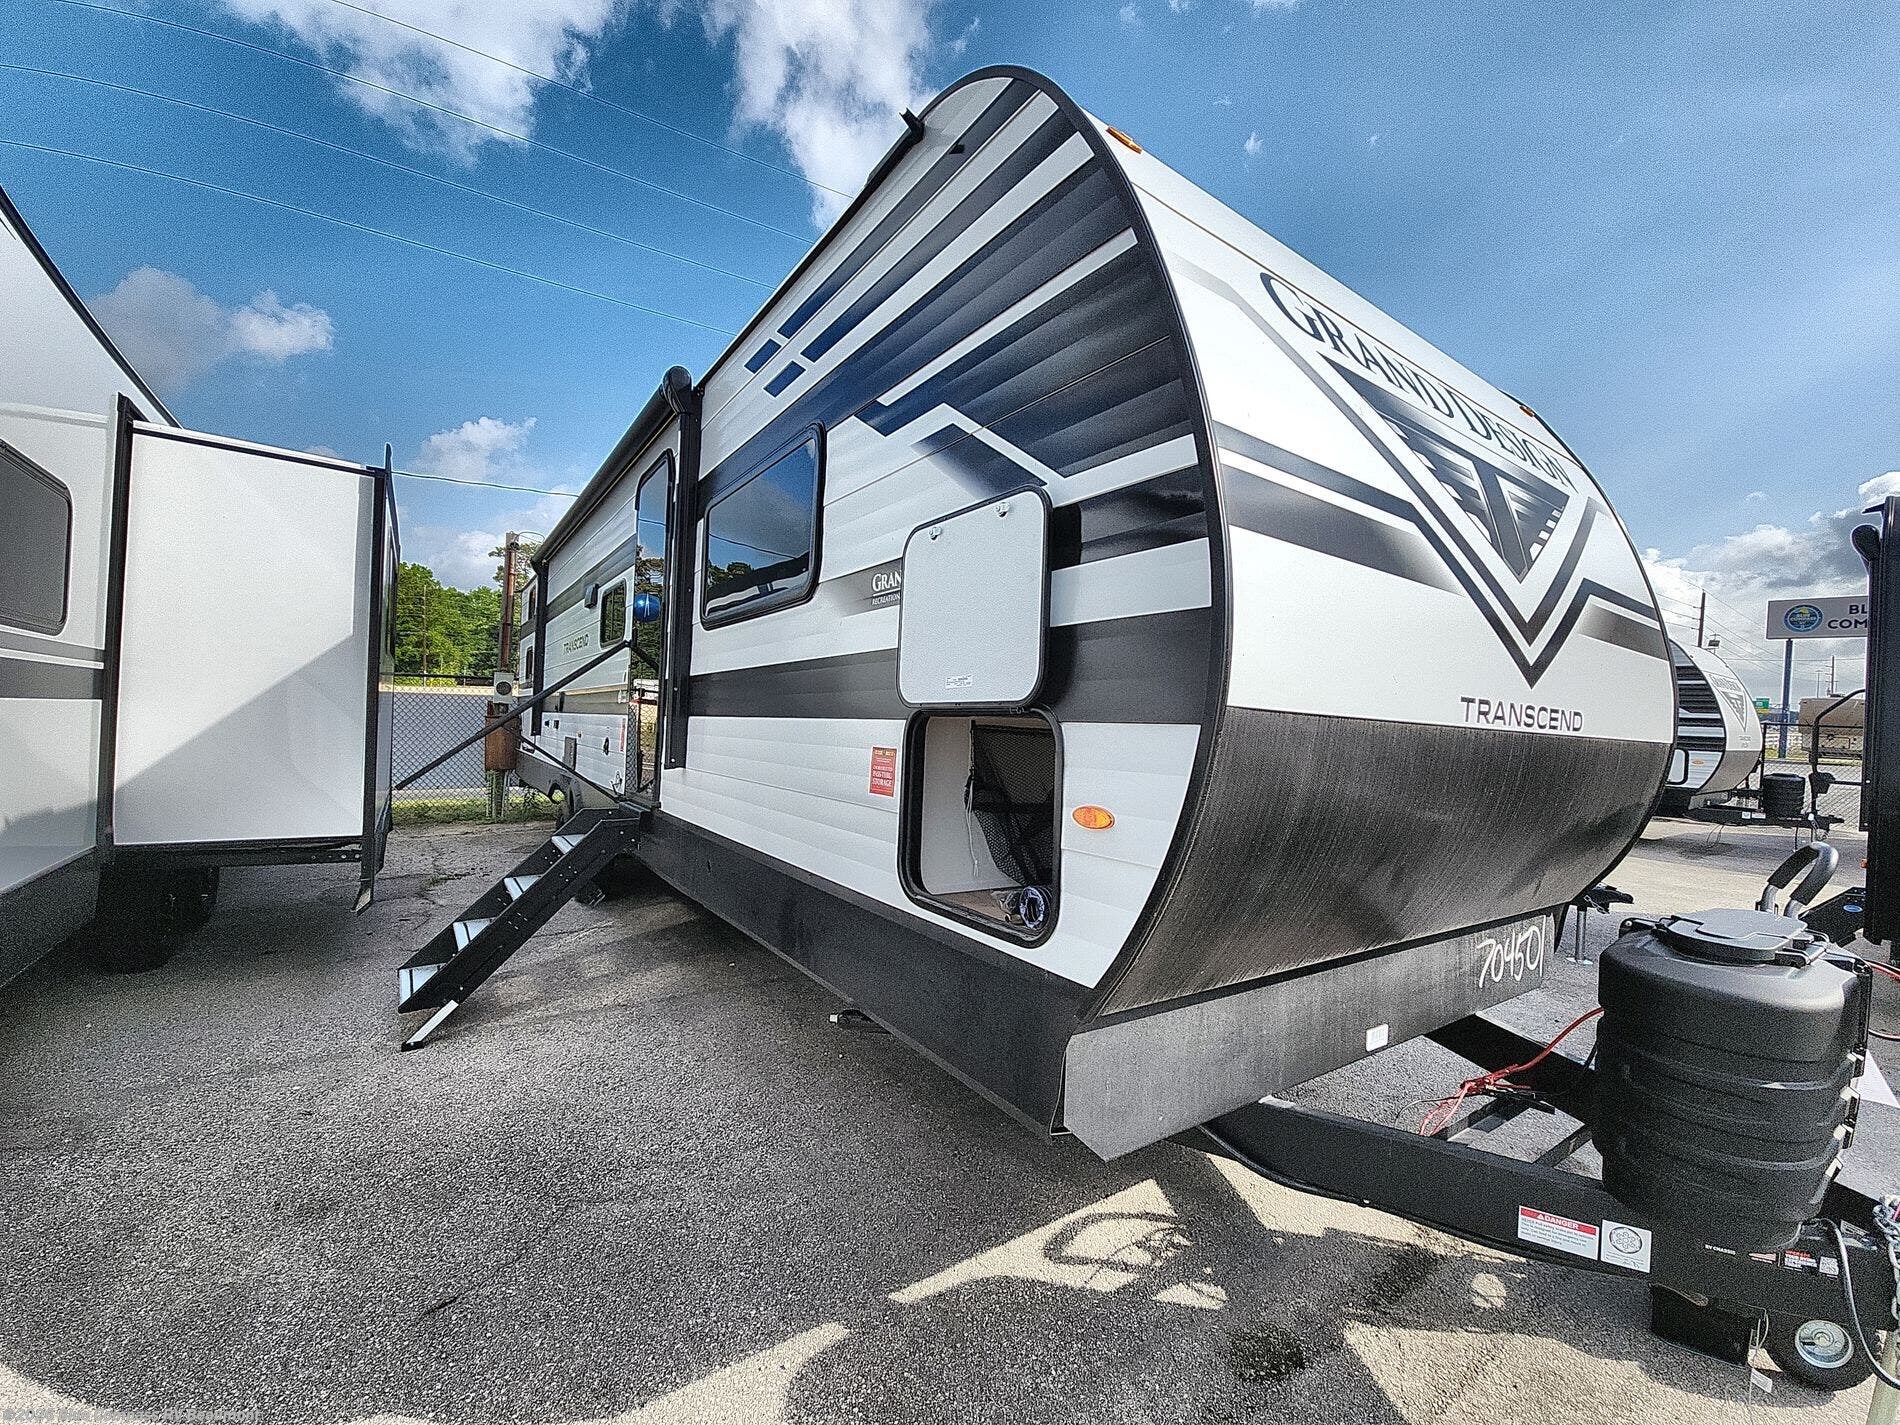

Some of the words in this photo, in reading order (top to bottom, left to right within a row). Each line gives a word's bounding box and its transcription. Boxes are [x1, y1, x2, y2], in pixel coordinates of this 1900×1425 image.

[1259, 271, 1455, 419] GRAND
[1439, 382, 1579, 494] DESIGN
[1460, 695, 1584, 733] TRANSCEND
[1543, 1213, 1580, 1230] DANGER
